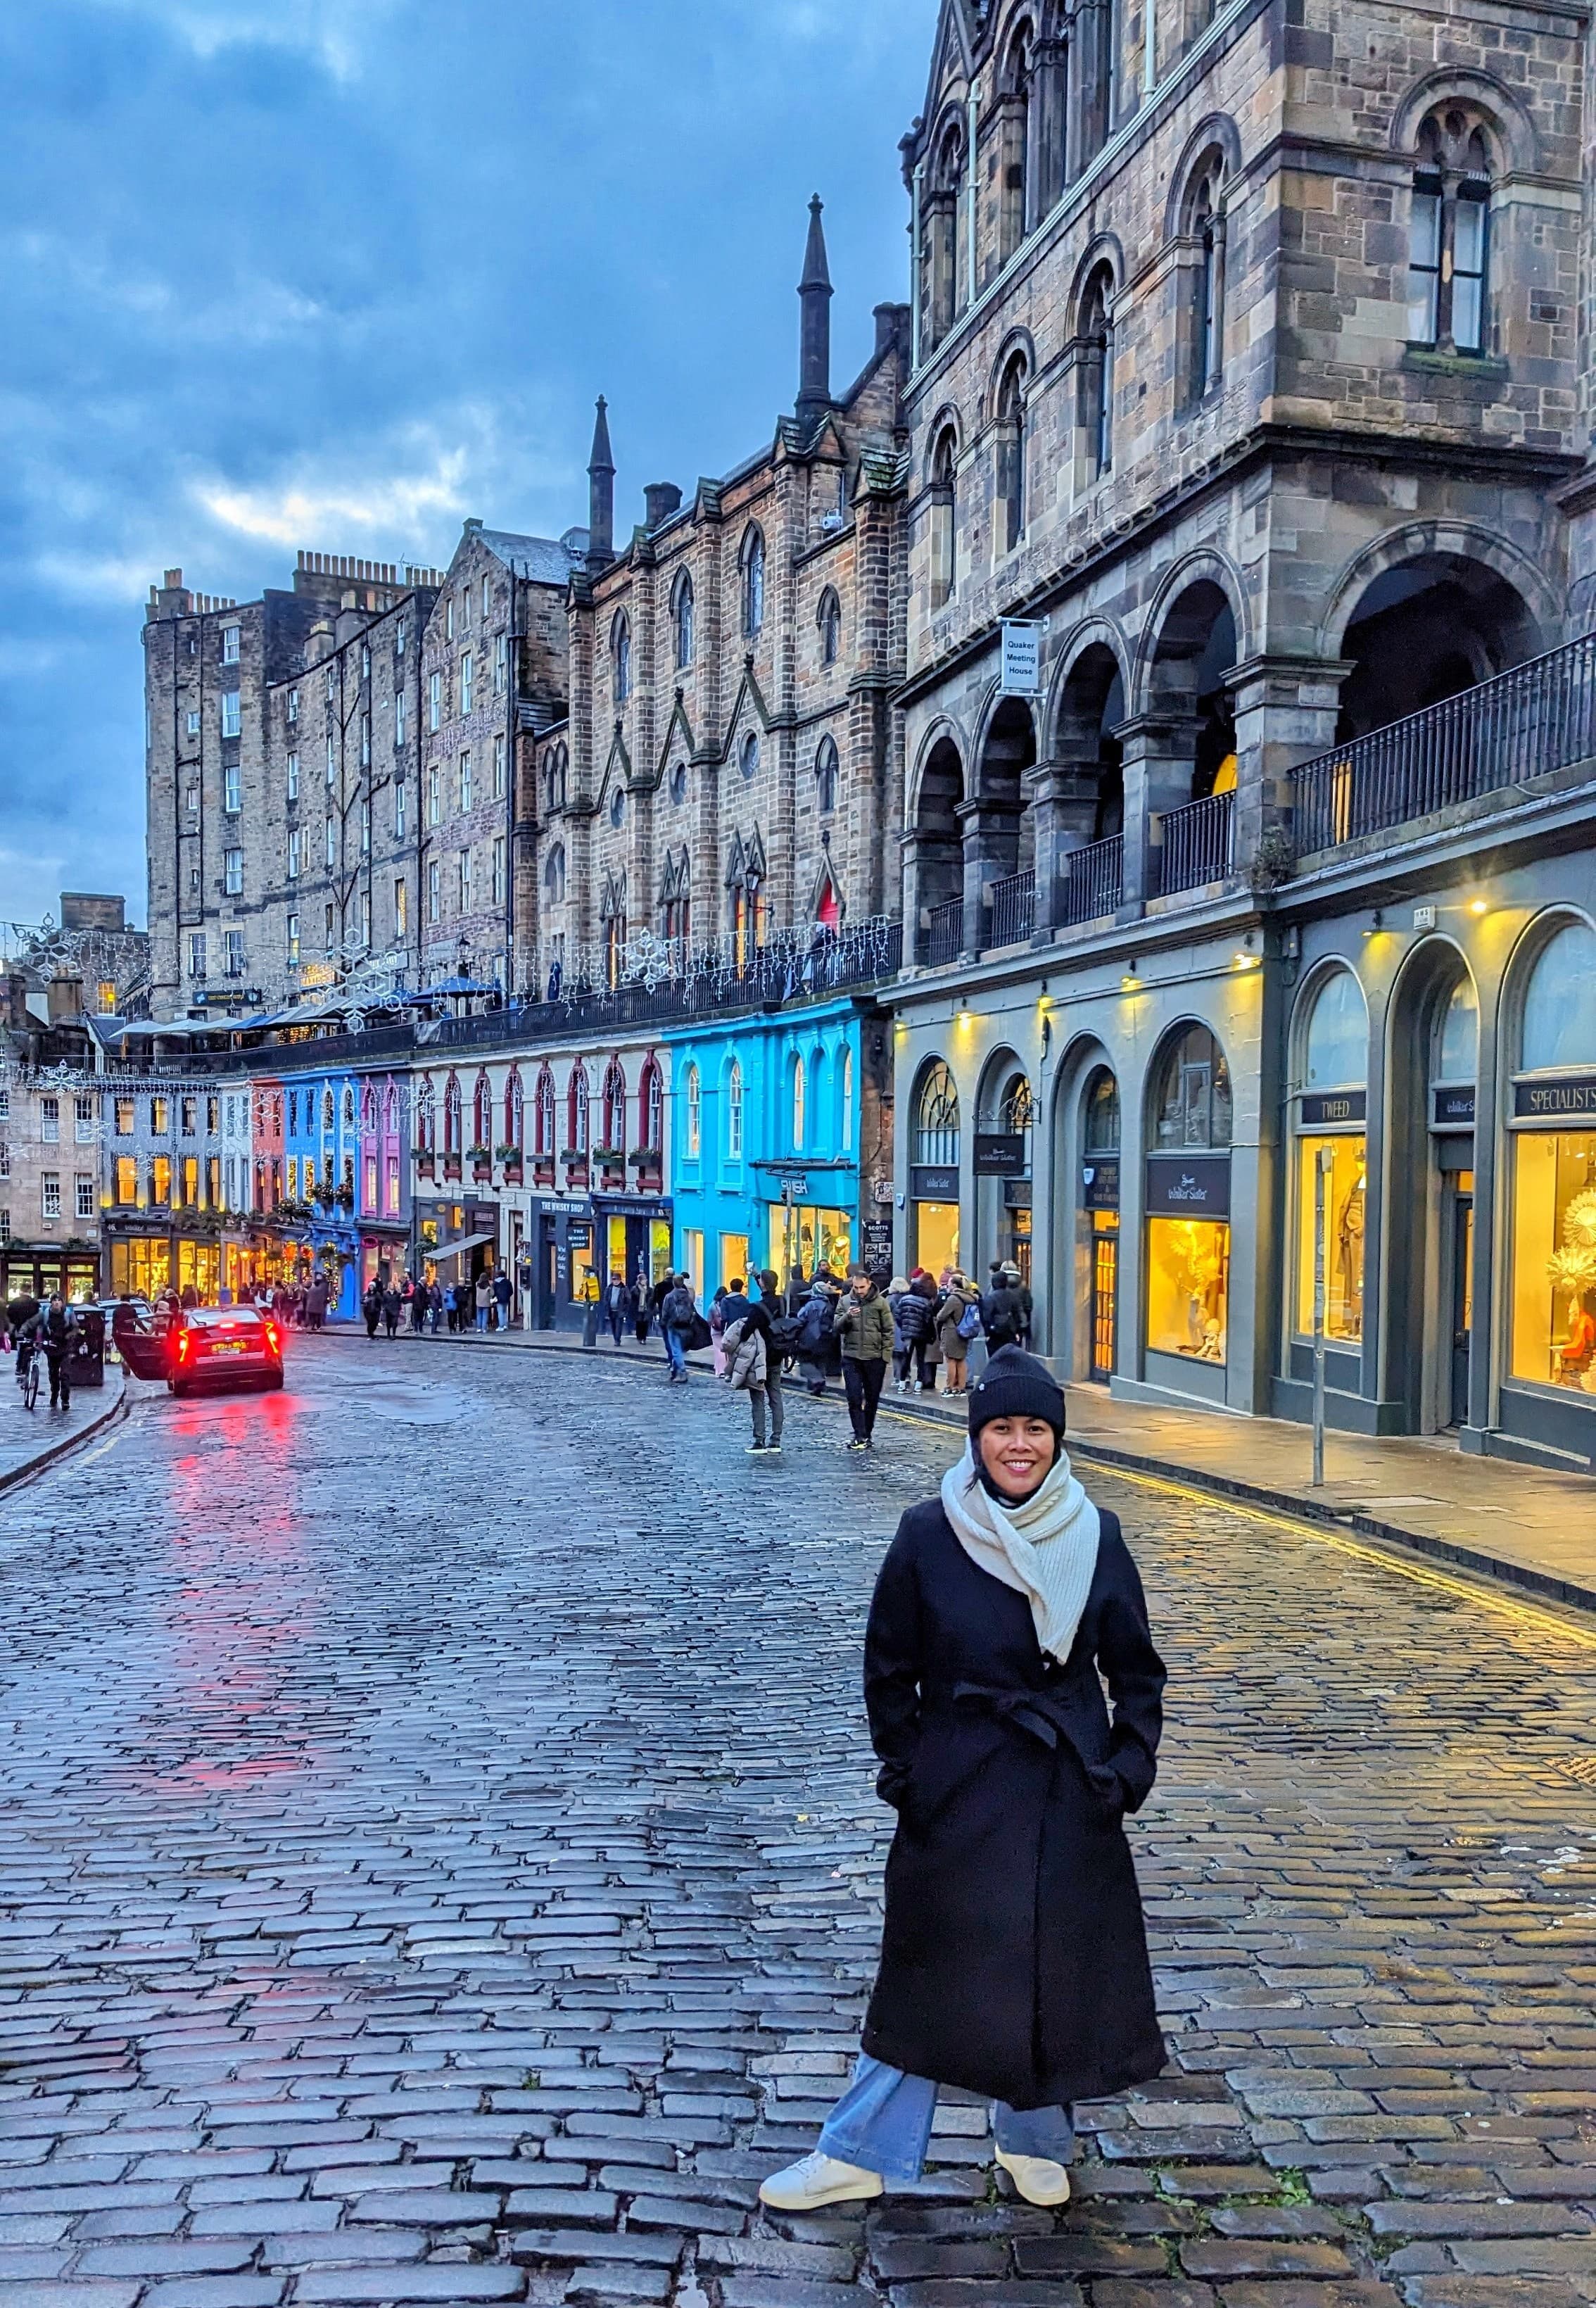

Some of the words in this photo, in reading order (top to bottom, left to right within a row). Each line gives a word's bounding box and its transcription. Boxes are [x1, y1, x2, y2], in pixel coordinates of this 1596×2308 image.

[1008, 641, 1034, 649] Quaker
[1006, 653, 1036, 664] Meeting
[1008, 667, 1033, 675] House
[1531, 1087, 1596, 1110] SPECIALISTS
[1321, 1100, 1350, 1118] TWEED
[541, 1201, 551, 1210] THE
[552, 1202, 570, 1211] WHISKY
[571, 1204, 584, 1213] SHOP
